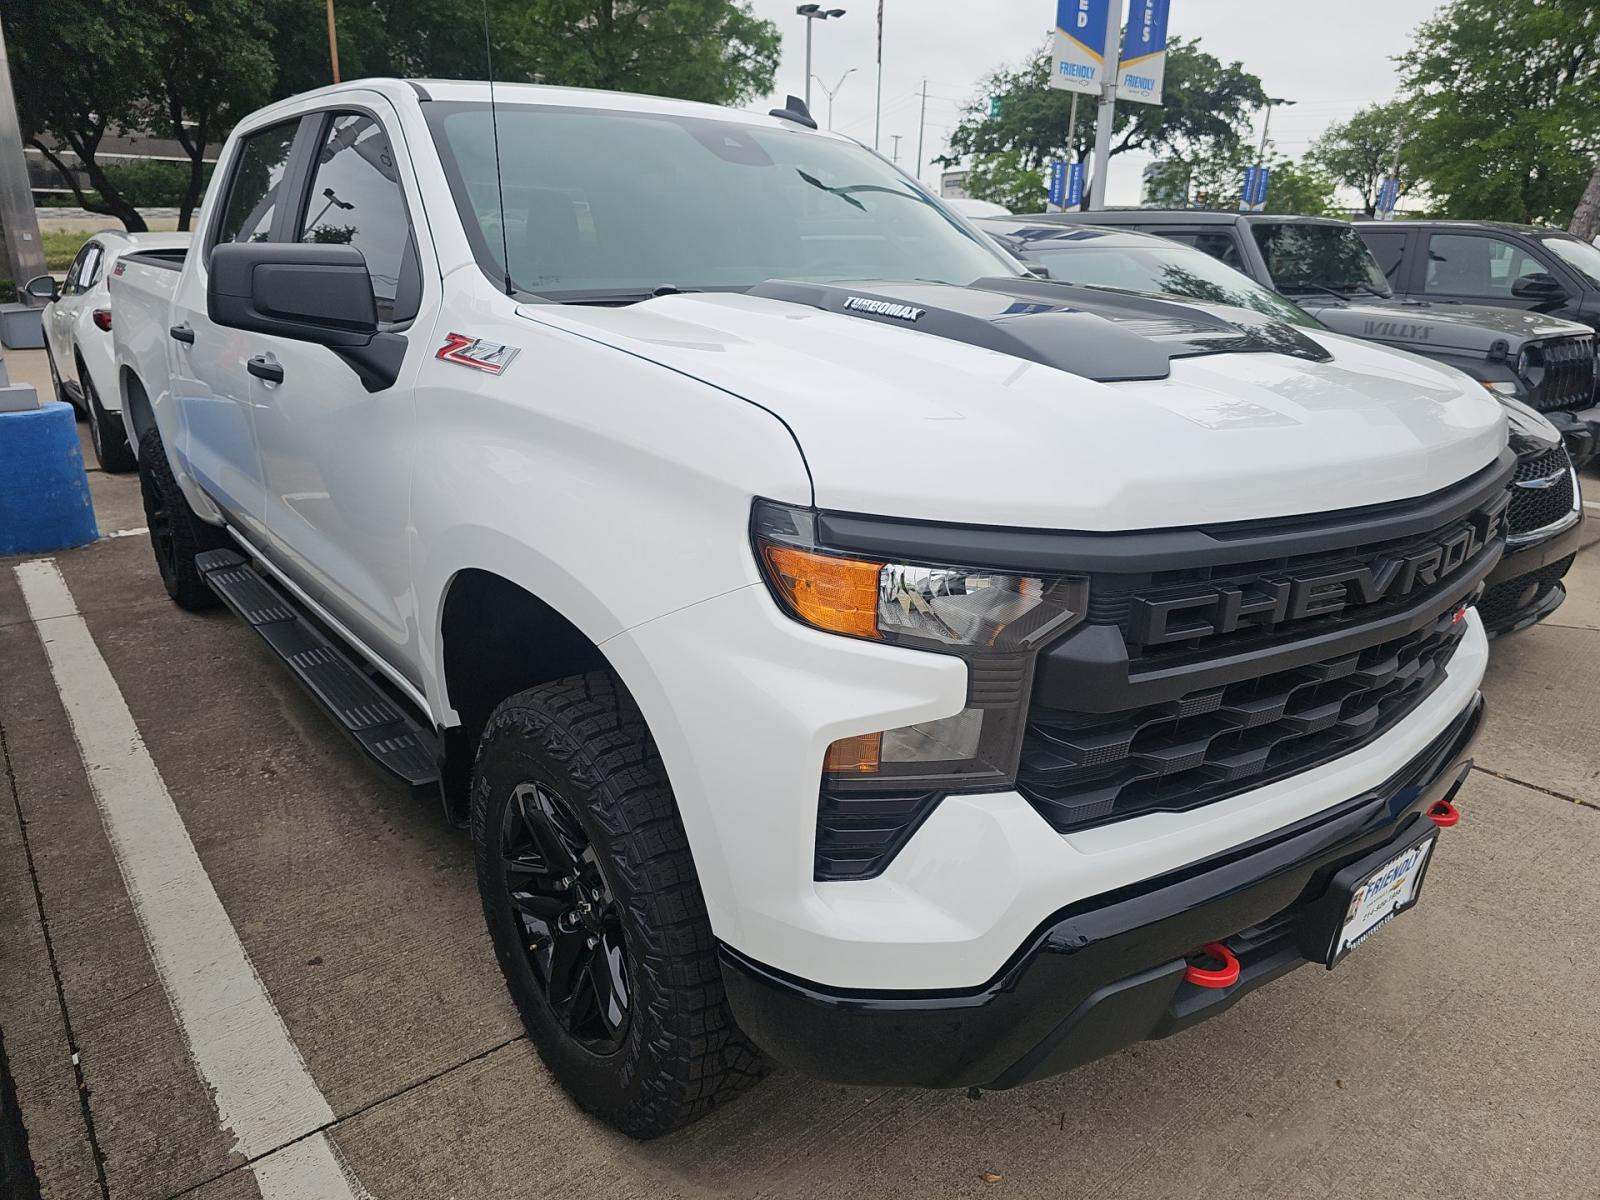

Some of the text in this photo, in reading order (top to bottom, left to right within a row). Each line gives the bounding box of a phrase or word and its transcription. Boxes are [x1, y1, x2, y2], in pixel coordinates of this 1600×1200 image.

[1060, 61, 1096, 80] FRIENDLY
[1124, 74, 1155, 91] FRIENDLY
[843, 296, 924, 321] TURBOMAX
[1364, 321, 1434, 339] WILLYS
[434, 332, 521, 376] Z71
[1364, 851, 1421, 902] FRIENDLY
